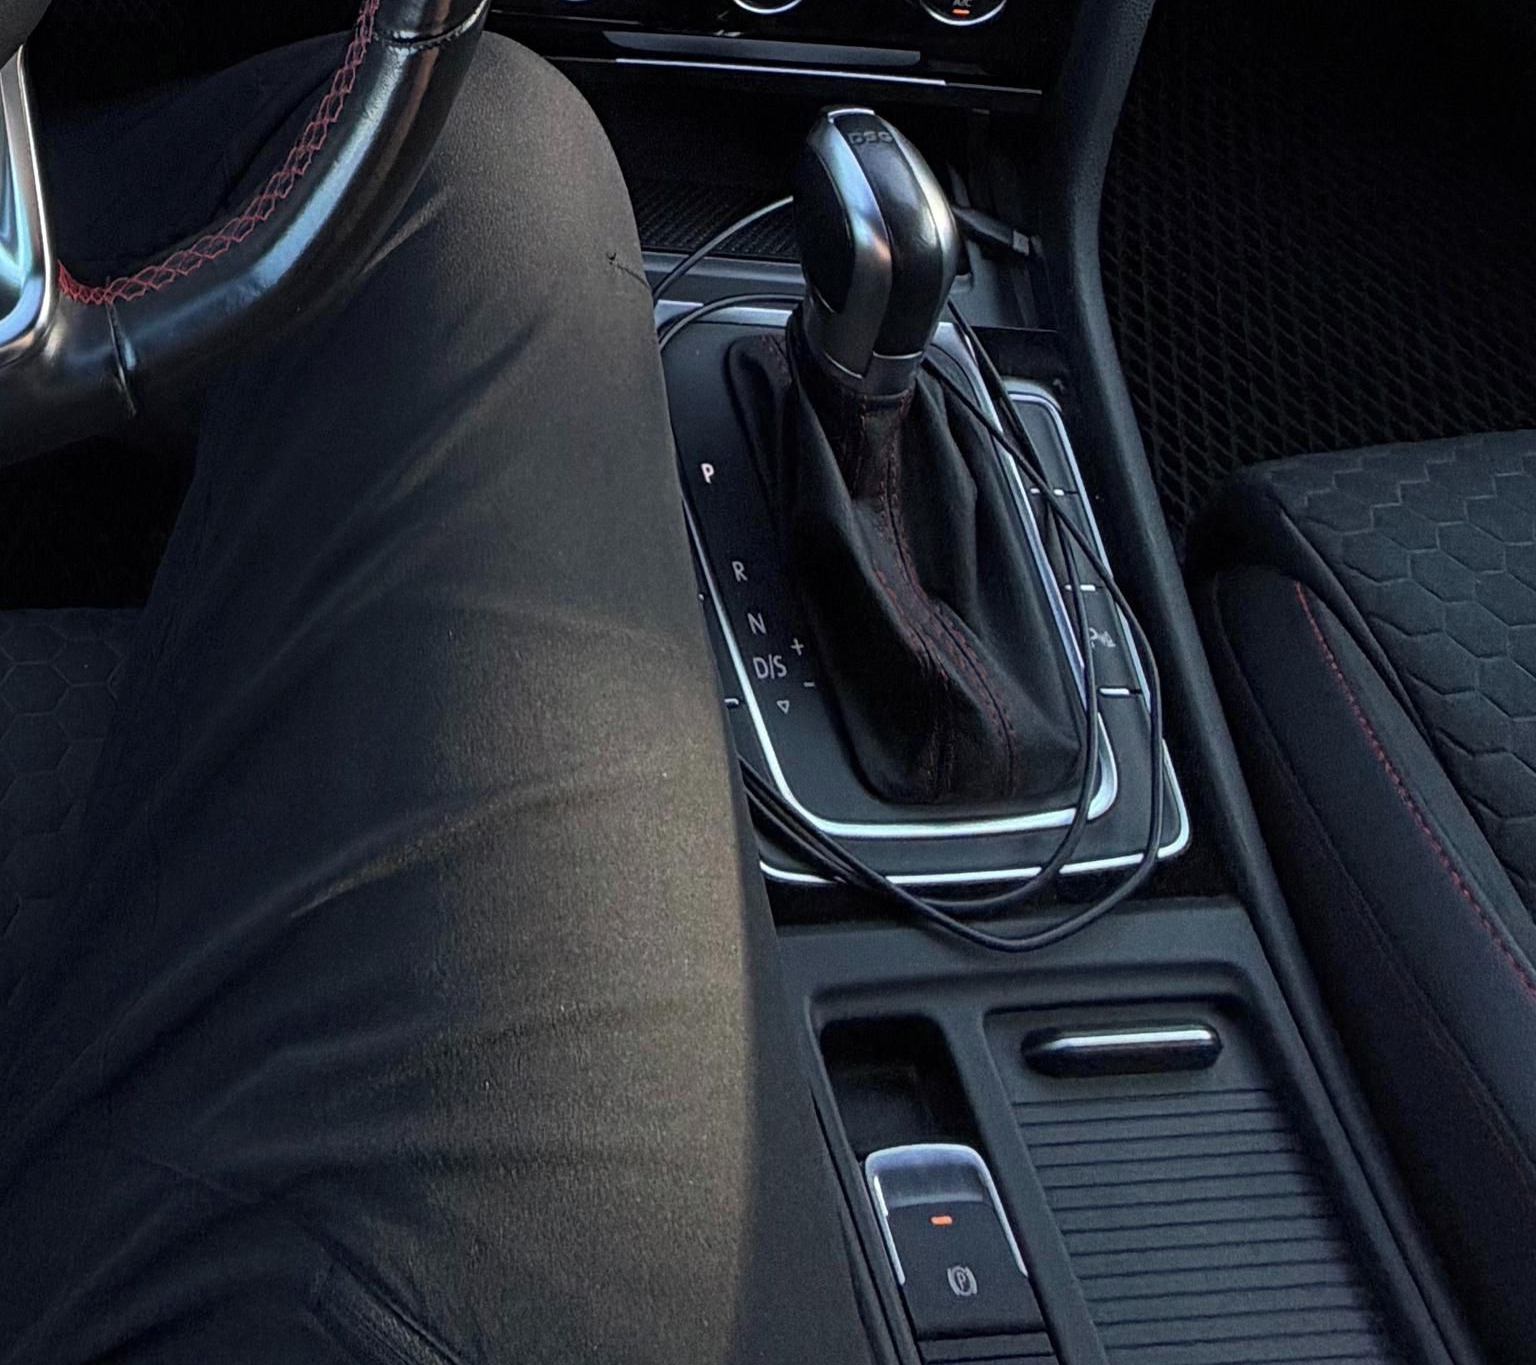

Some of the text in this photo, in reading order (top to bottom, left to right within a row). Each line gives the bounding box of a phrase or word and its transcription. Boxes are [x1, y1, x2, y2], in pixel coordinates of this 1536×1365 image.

[701, 463, 715, 484] P
[732, 560, 748, 582] R
[747, 612, 767, 635] N
[753, 653, 787, 680] D/S
